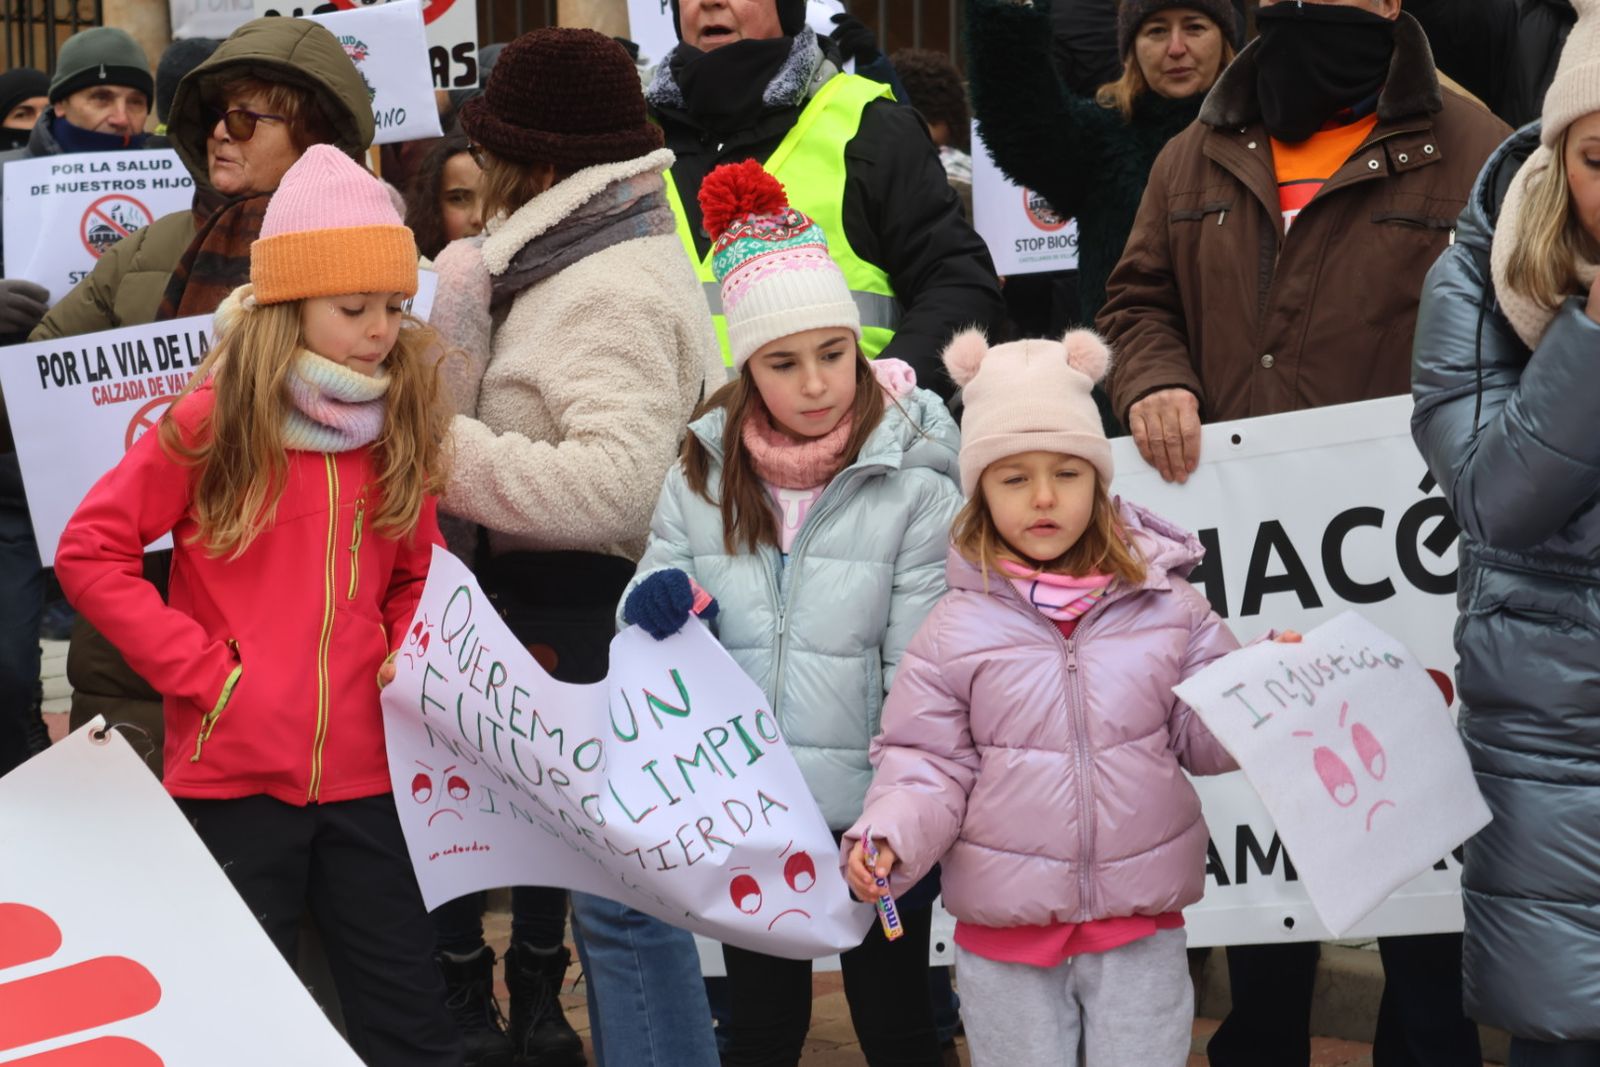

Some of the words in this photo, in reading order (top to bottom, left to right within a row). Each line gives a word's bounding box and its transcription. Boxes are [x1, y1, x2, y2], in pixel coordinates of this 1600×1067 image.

[428, 42, 477, 88] AS
[374, 107, 406, 129] ANO
[52, 163, 84, 175] POR
[90, 162, 110, 173] LA
[117, 159, 172, 172] SALUD
[31, 185, 50, 196] DE
[55, 179, 146, 194] NUESTROS
[152, 177, 193, 188] HIJO
[1015, 237, 1045, 252] STOP
[1047, 234, 1077, 249] BIOG
[69, 271, 86, 285] ST
[36, 351, 81, 389] POR
[81, 346, 113, 382] LA
[112, 339, 152, 377] VIA
[153, 334, 184, 371] DE
[92, 380, 147, 406] CALZADA
[147, 376, 165, 396] DE
[441, 585, 608, 774] QUEREMO
[609, 669, 690, 743] UN
[1222, 644, 1404, 730] Injusticia
[421, 662, 607, 827] FUTURO
[608, 708, 779, 823] LIMPIO
[603, 789, 789, 872] MIERDA
